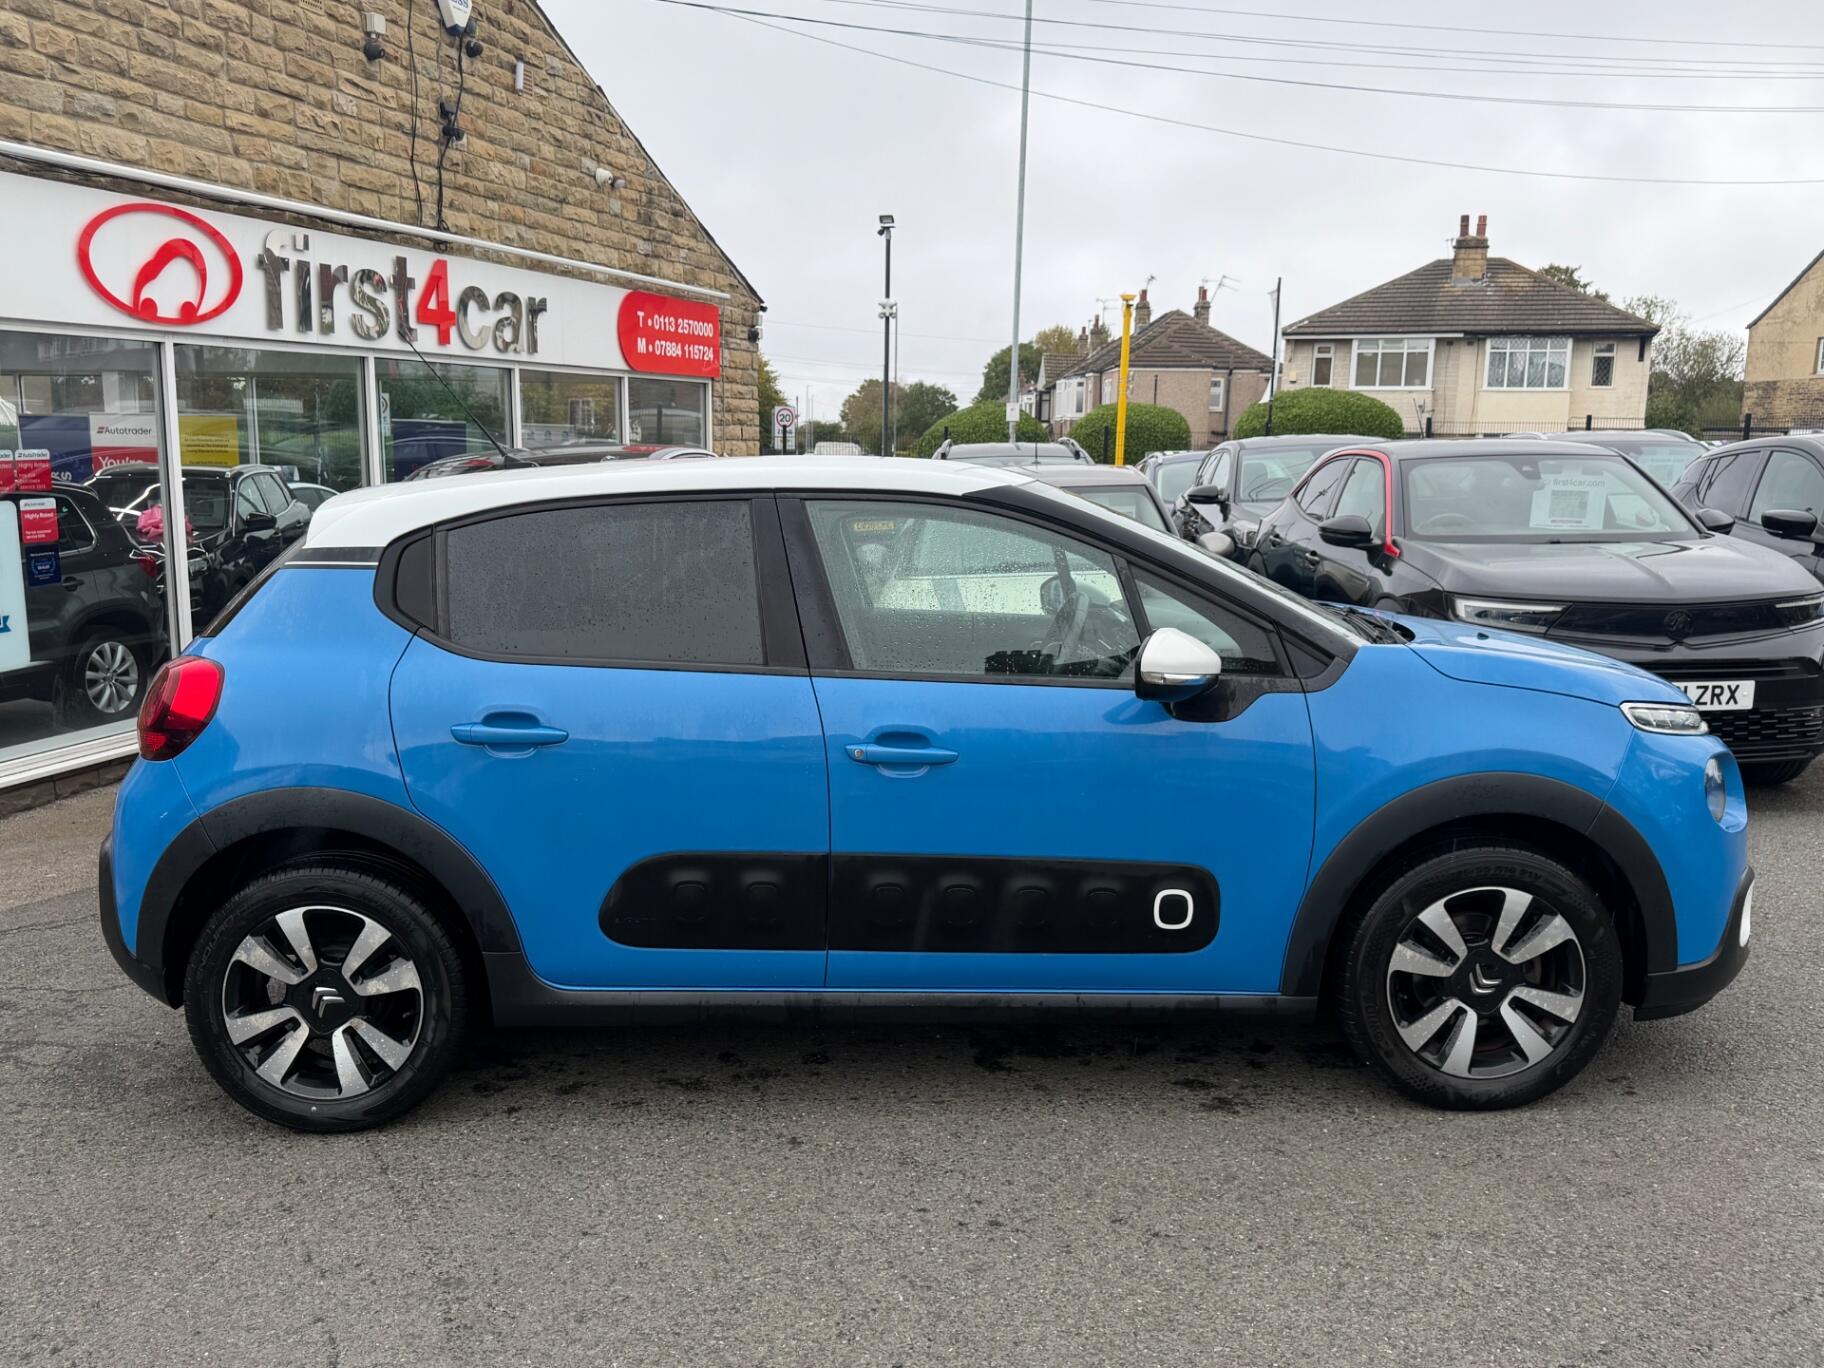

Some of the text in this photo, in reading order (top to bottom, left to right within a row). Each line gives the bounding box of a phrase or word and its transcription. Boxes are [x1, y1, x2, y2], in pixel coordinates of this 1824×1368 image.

[257, 229, 547, 354] first4car
[637, 311, 714, 338] T 0113 2570000
[637, 337, 714, 362] M 07884 115724
[105, 425, 152, 435] Autotrader
[779, 413, 791, 423] 20
